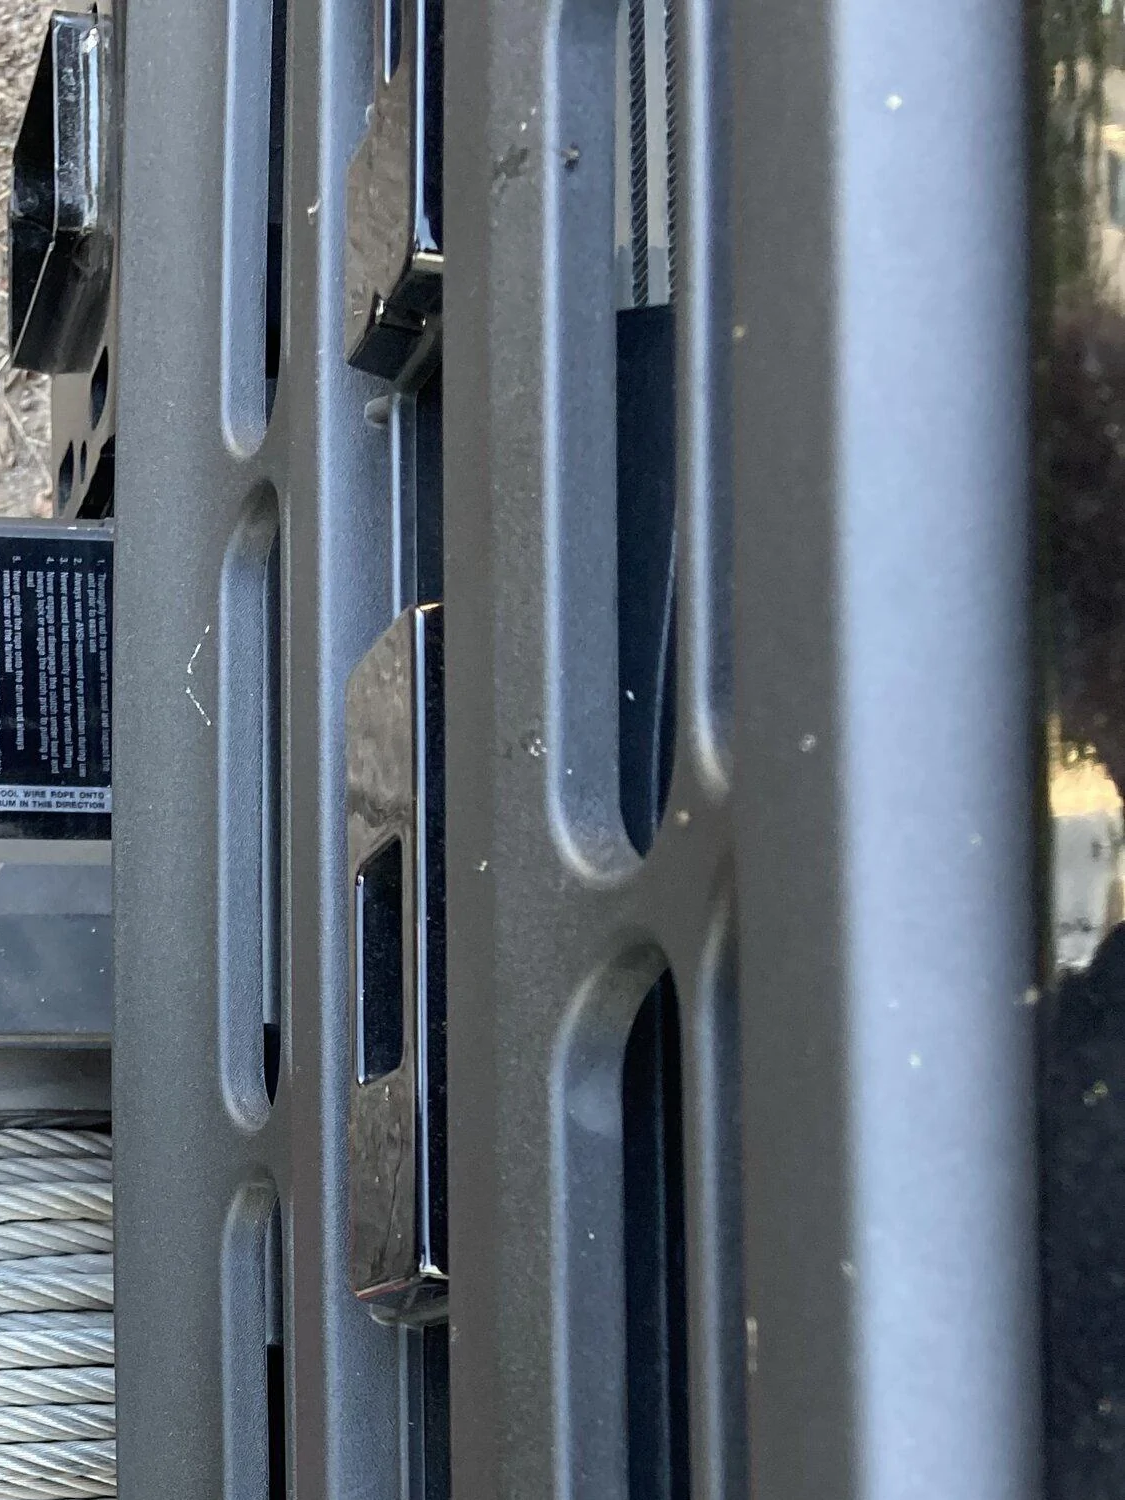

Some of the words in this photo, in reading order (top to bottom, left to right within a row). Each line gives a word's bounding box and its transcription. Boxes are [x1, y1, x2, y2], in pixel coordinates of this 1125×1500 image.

[46, 556, 54, 564] 4.
[3, 570, 11, 597] remain
[13, 571, 21, 592] Never
[27, 571, 35, 587] load
[36, 571, 44, 598] always
[73, 572, 82, 599] Always
[88, 573, 96, 589] unit
[87, 590, 96, 608] prior
[97, 573, 107, 615] Thoroughly
[4, 598, 12, 617] clear
[12, 595, 22, 616] guide
[37, 599, 45, 615] lock
[46, 596, 54, 624] engage
[61, 596, 69, 623] exceed
[89, 609, 96, 617] to
[14, 618, 22, 630] the
[38, 617, 45, 626] or
[48, 626, 55, 634] or
[89, 619, 97, 637] each
[98, 617, 107, 634] read
[14, 632, 22, 649] rope
[36, 627, 46, 655] engage
[62, 625, 70, 641] load
[99, 636, 107, 648] the
[48, 635, 56, 674] disengage
[61, 643, 71, 675] capacity
[75, 622, 85, 678] ANSI-approved
[15, 651, 23, 668] onto
[39, 657, 47, 670] the
[15, 670, 23, 682] the
[39, 672, 47, 695] clutch
[49, 677, 57, 689] the
[64, 677, 70, 685] or
[15, 684, 24, 704] drum
[75, 680, 84, 694] eye
[39, 697, 48, 715] prior
[50, 691, 58, 714] clutch
[101, 683, 109, 711] manual
[16, 707, 24, 721] and
[64, 703, 72, 713] for
[77, 696, 86, 734] protection
[41, 717, 48, 725] to
[50, 716, 58, 739] under
[64, 715, 72, 744] vertical
[15, 723, 25, 750] always
[39, 727, 48, 753] pulling
[51, 741, 59, 757] load
[77, 736, 86, 761] during
[51, 759, 59, 773] and
